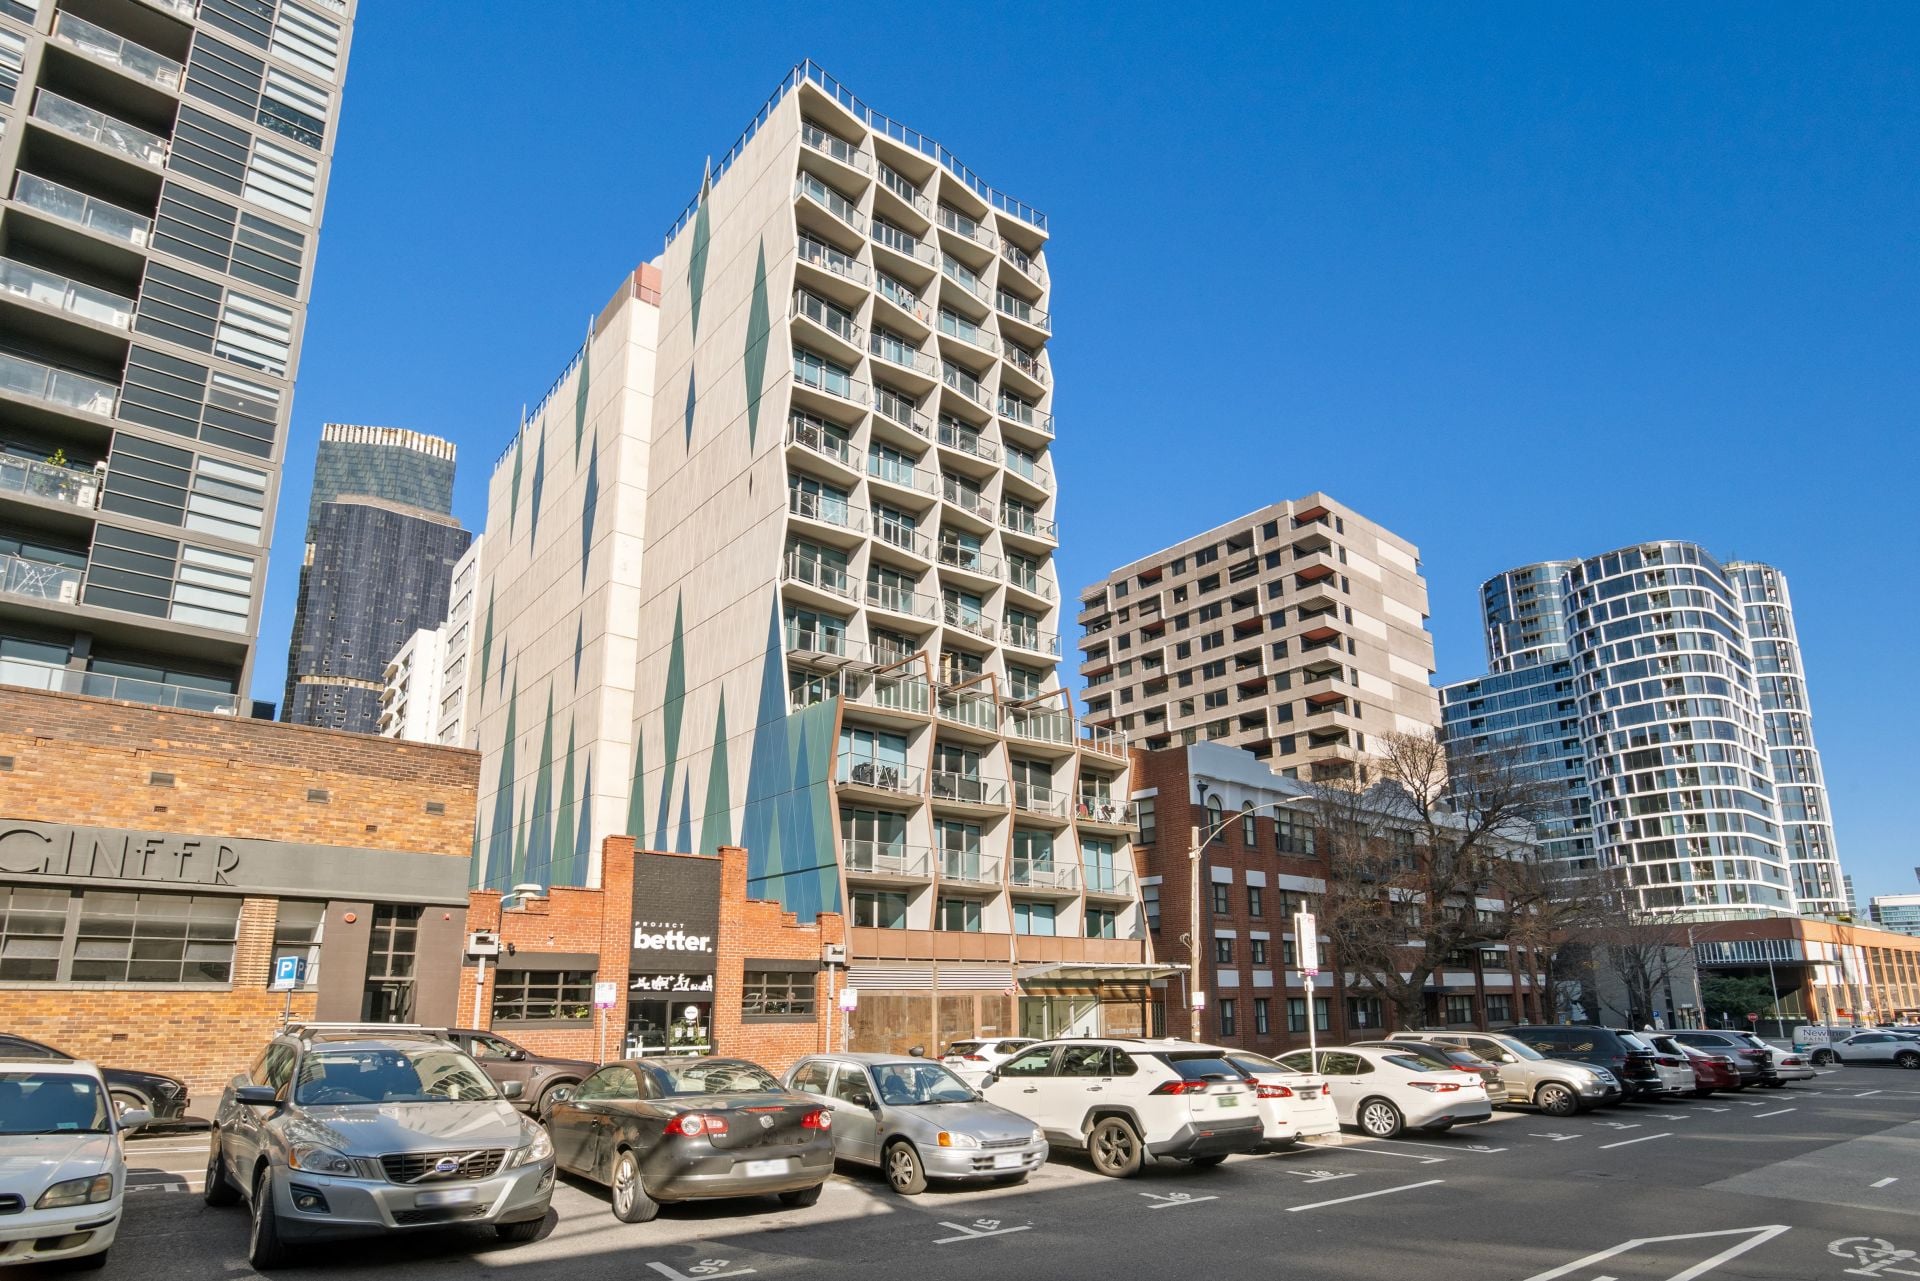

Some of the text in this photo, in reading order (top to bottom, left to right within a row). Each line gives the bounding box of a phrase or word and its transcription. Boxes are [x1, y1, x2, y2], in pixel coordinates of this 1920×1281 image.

[634, 927, 713, 953] better.
[280, 961, 293, 977] P
[972, 1218, 1001, 1230] 57
[688, 1258, 731, 1274] 56
